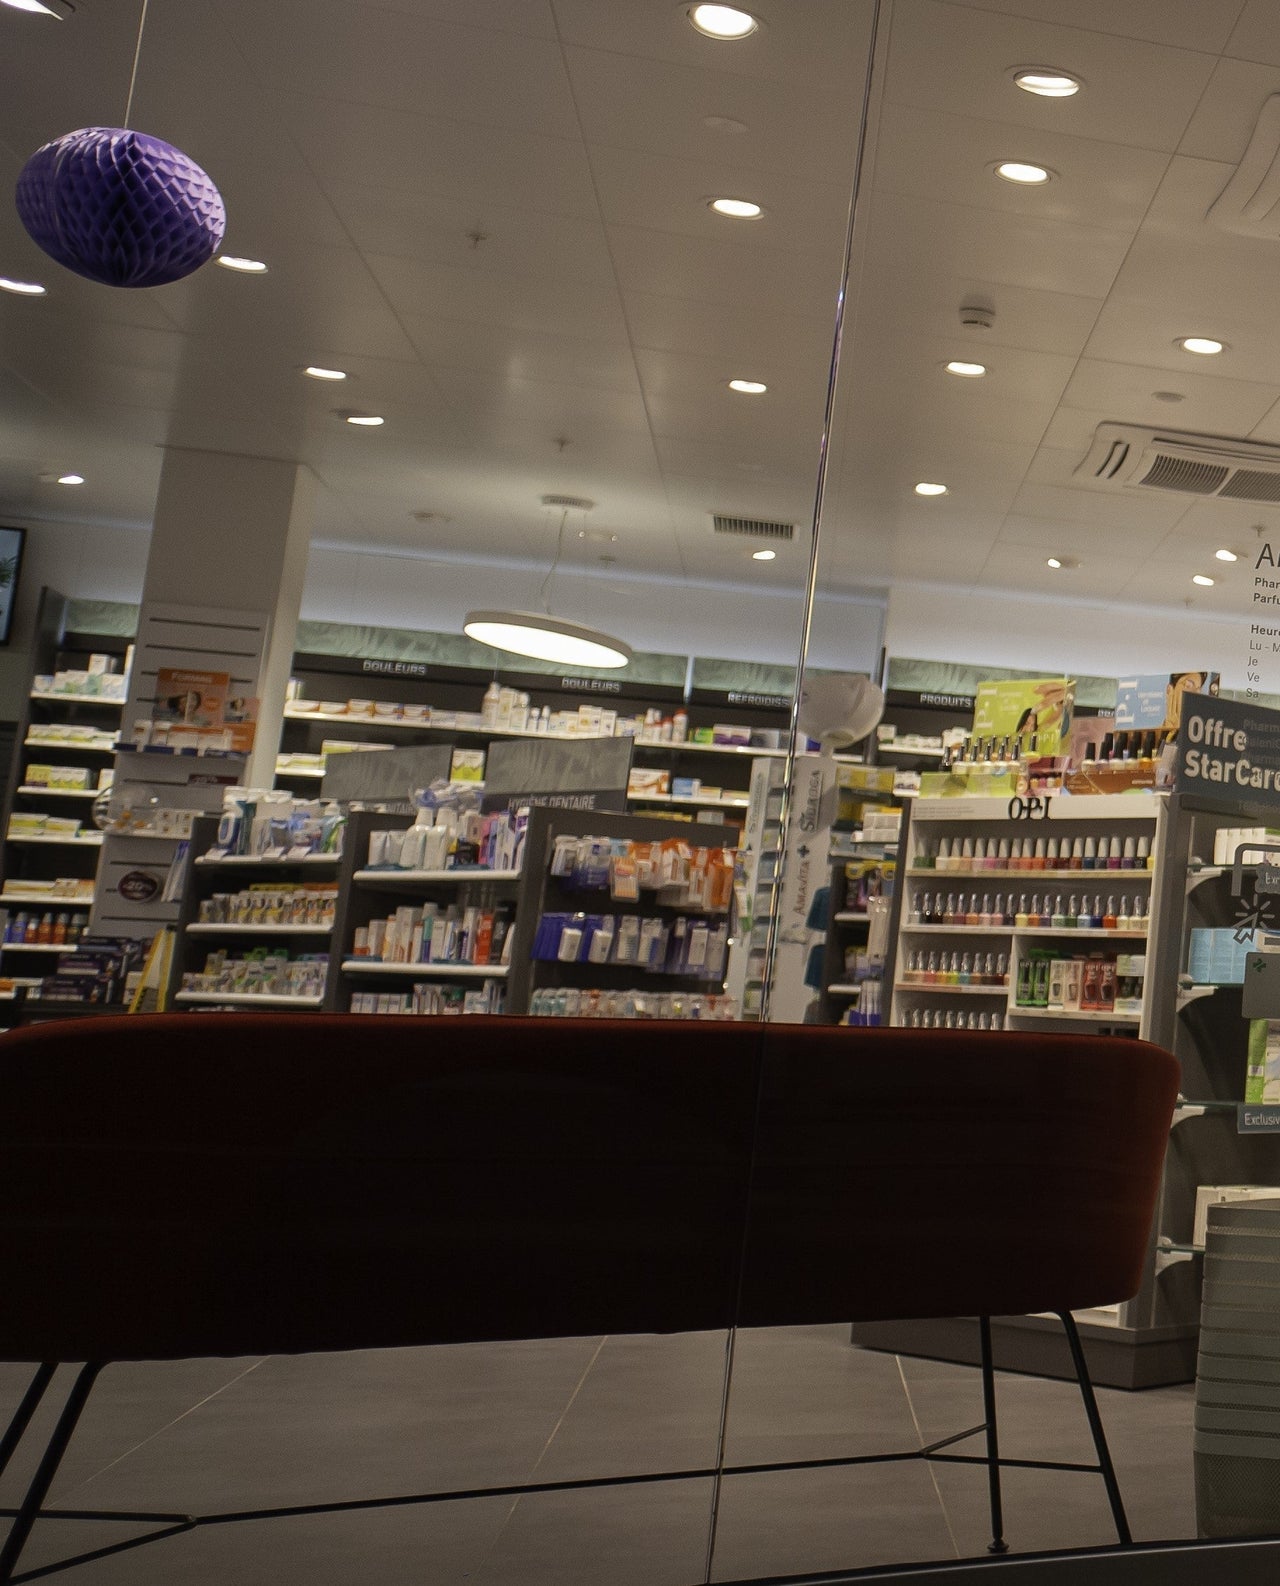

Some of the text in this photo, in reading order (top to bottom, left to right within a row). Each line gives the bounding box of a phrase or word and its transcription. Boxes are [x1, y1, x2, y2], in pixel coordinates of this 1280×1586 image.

[1249, 640, 1262, 651] Lu
[363, 660, 427, 677] DOULEURS
[1247, 656, 1258, 667] Je
[1247, 671, 1260, 683] Ve
[562, 677, 622, 693] DOULEURS
[1246, 687, 1259, 699] Sa
[920, 693, 972, 709] PRODUITS
[1187, 714, 1248, 753] Offre
